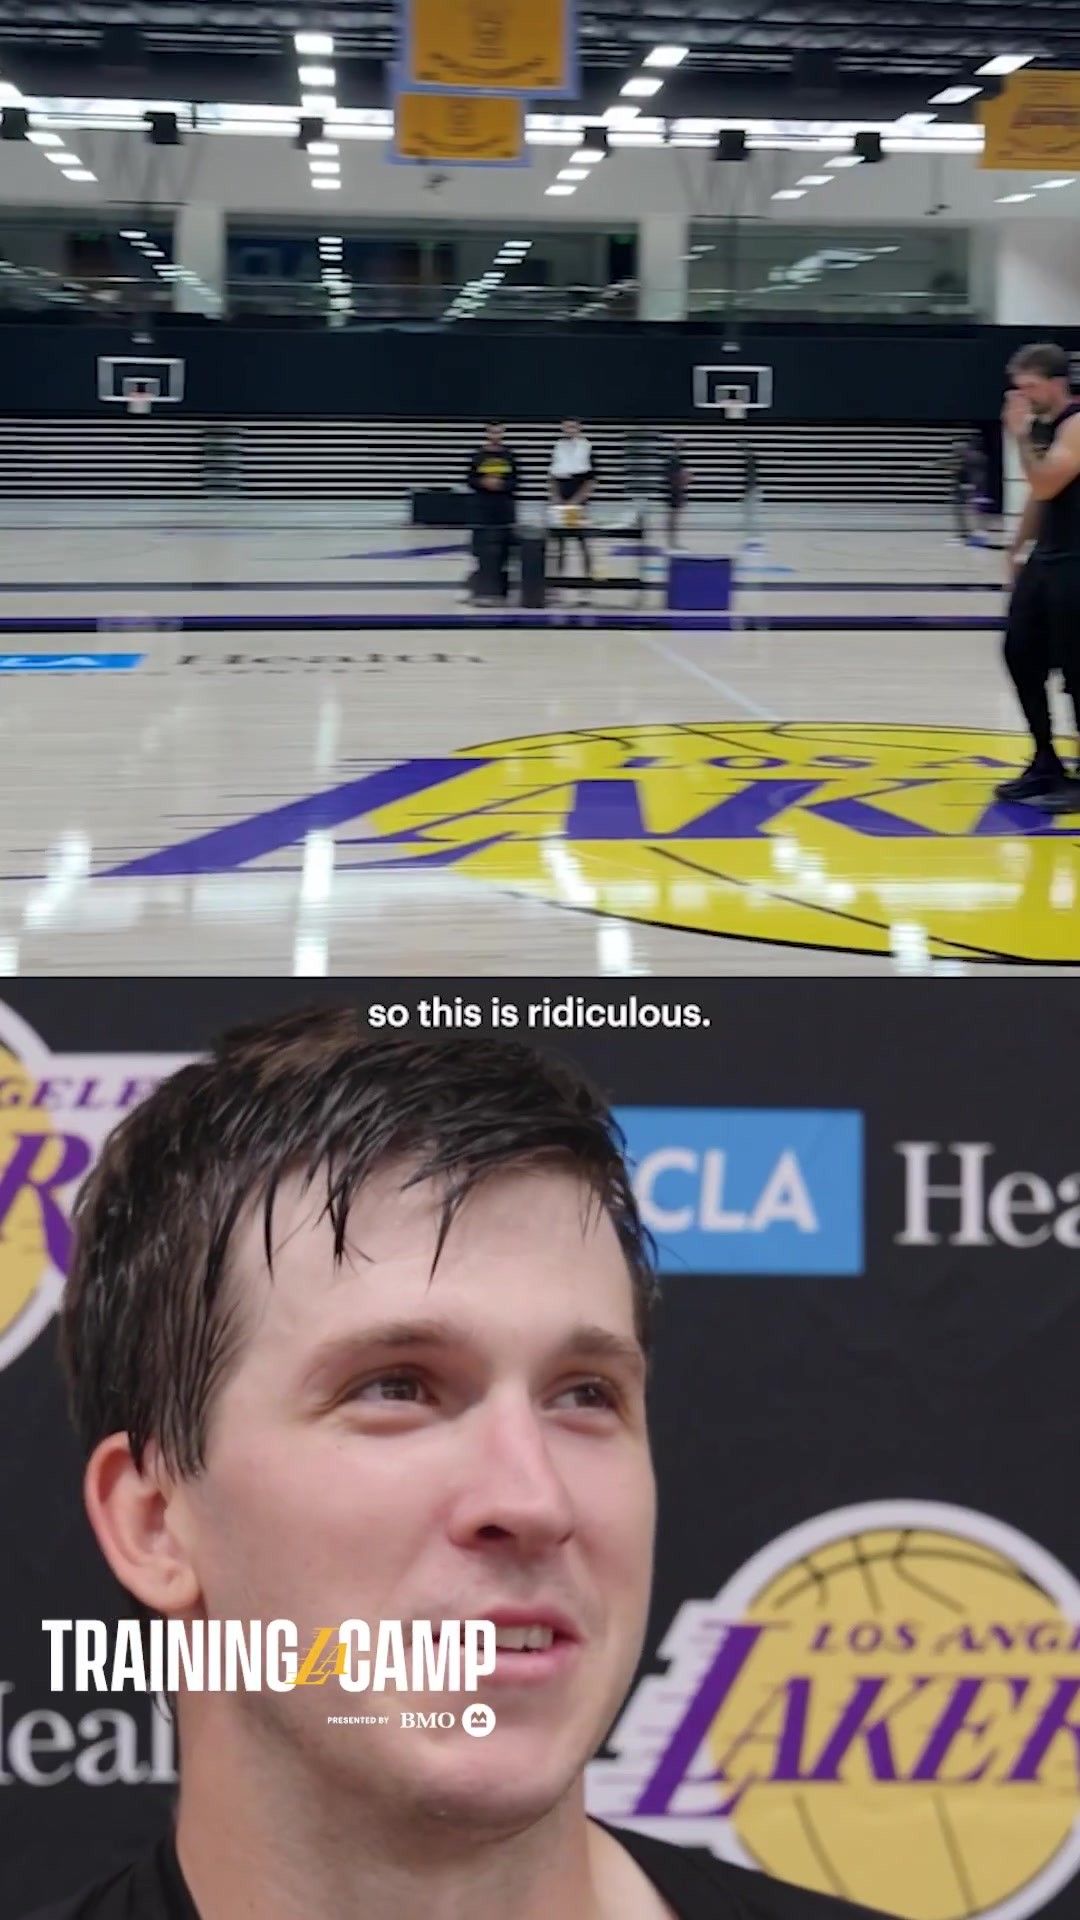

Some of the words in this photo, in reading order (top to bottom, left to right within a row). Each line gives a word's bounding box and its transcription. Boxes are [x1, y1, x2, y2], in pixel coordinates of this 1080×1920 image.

[610, 755, 876, 769] LOS
[807, 1621, 918, 1654] LOS
[0, 1679, 178, 1787] eal
